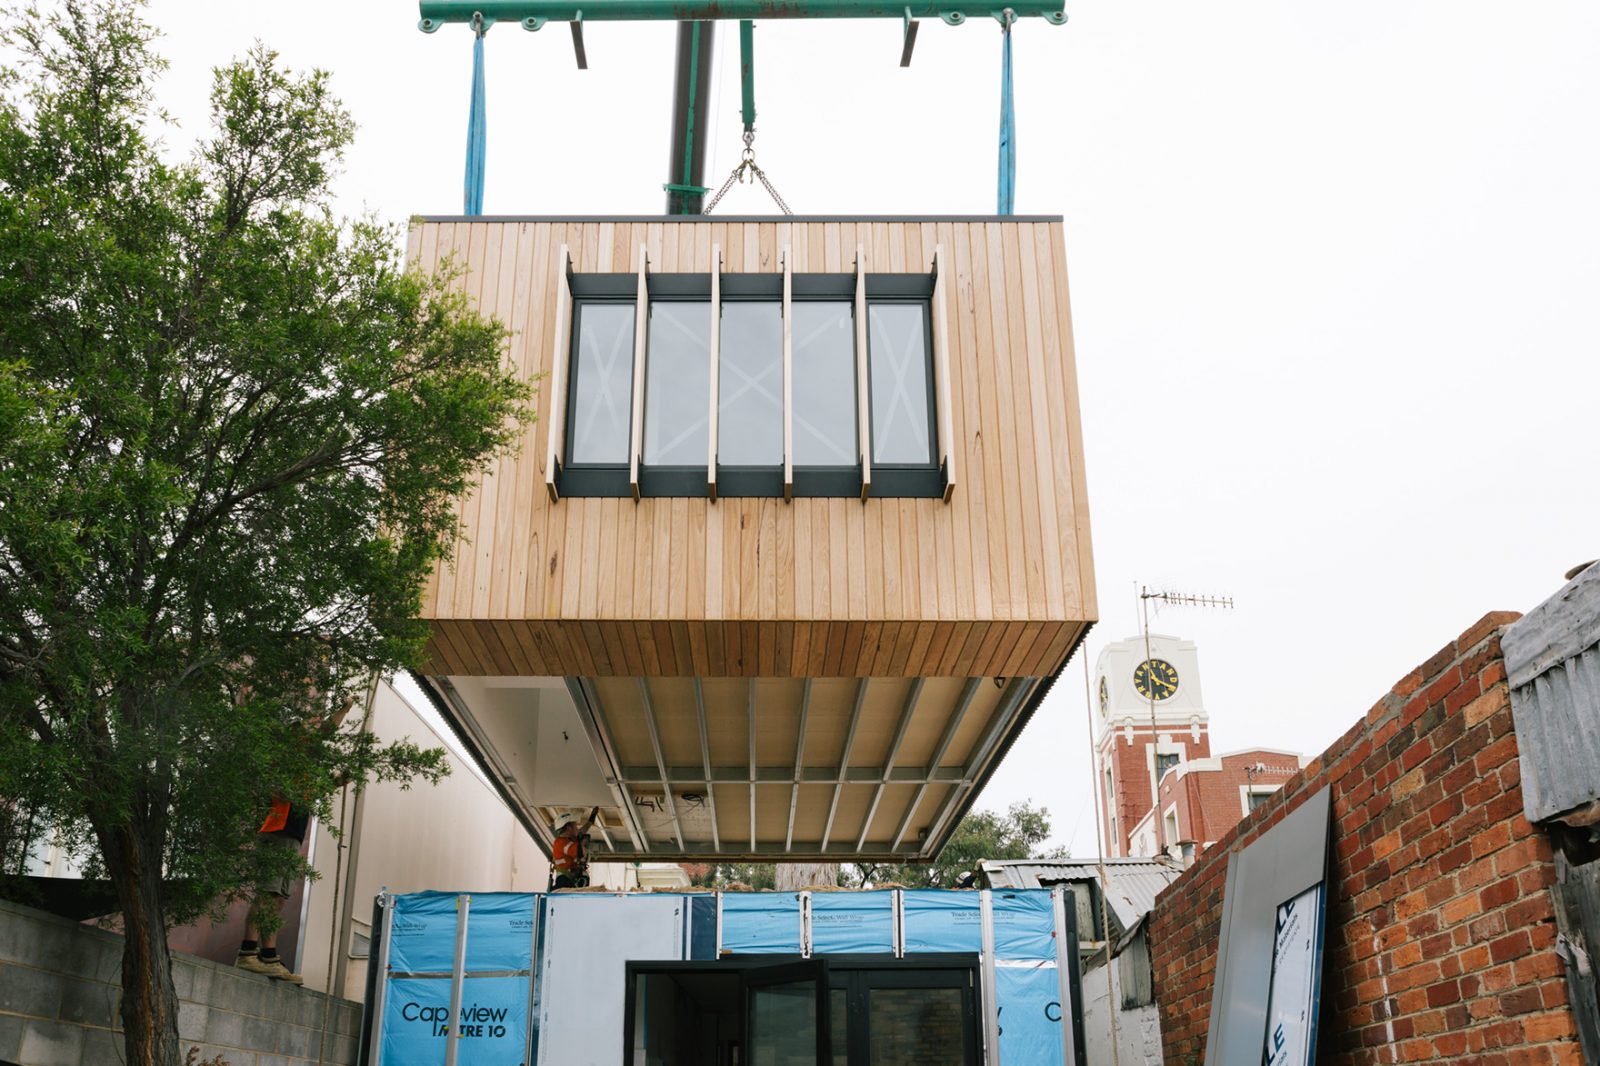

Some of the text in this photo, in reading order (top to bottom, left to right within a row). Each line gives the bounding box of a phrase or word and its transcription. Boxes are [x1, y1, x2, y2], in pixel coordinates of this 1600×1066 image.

[402, 1002, 508, 1037] Capview
[438, 1024, 506, 1038] MTRE 10
